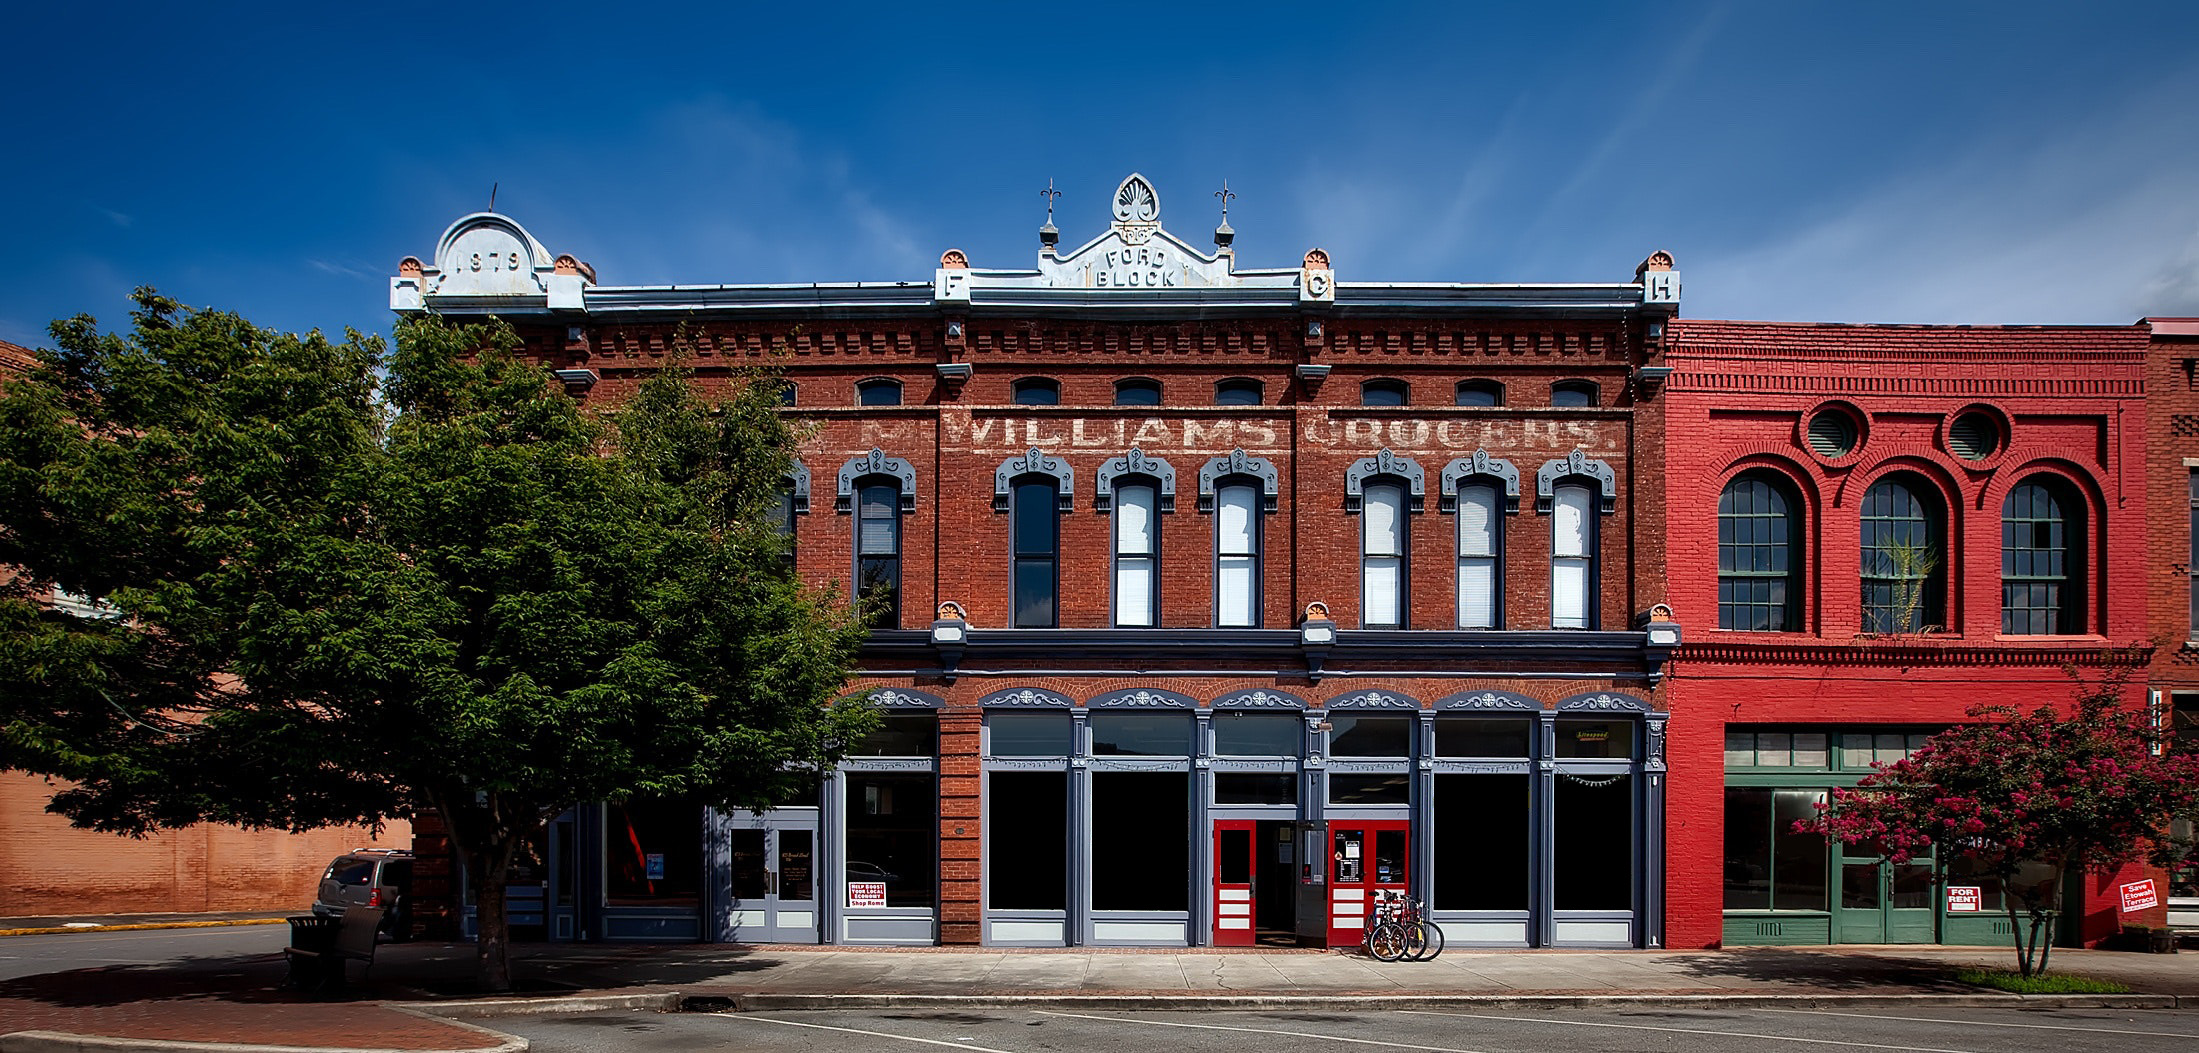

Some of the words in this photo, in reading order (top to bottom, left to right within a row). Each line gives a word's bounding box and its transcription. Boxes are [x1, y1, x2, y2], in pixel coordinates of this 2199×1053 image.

[456, 252, 520, 274] 1879
[1105, 248, 1165, 269] FORD
[944, 274, 964, 297] F
[1096, 271, 1175, 287] BLOCK
[1651, 275, 1672, 301] H
[942, 412, 1276, 447] WILLIAMS
[2124, 889, 2153, 900] Etowah
[2128, 884, 2147, 892] Save
[2125, 896, 2154, 906] Terrace
